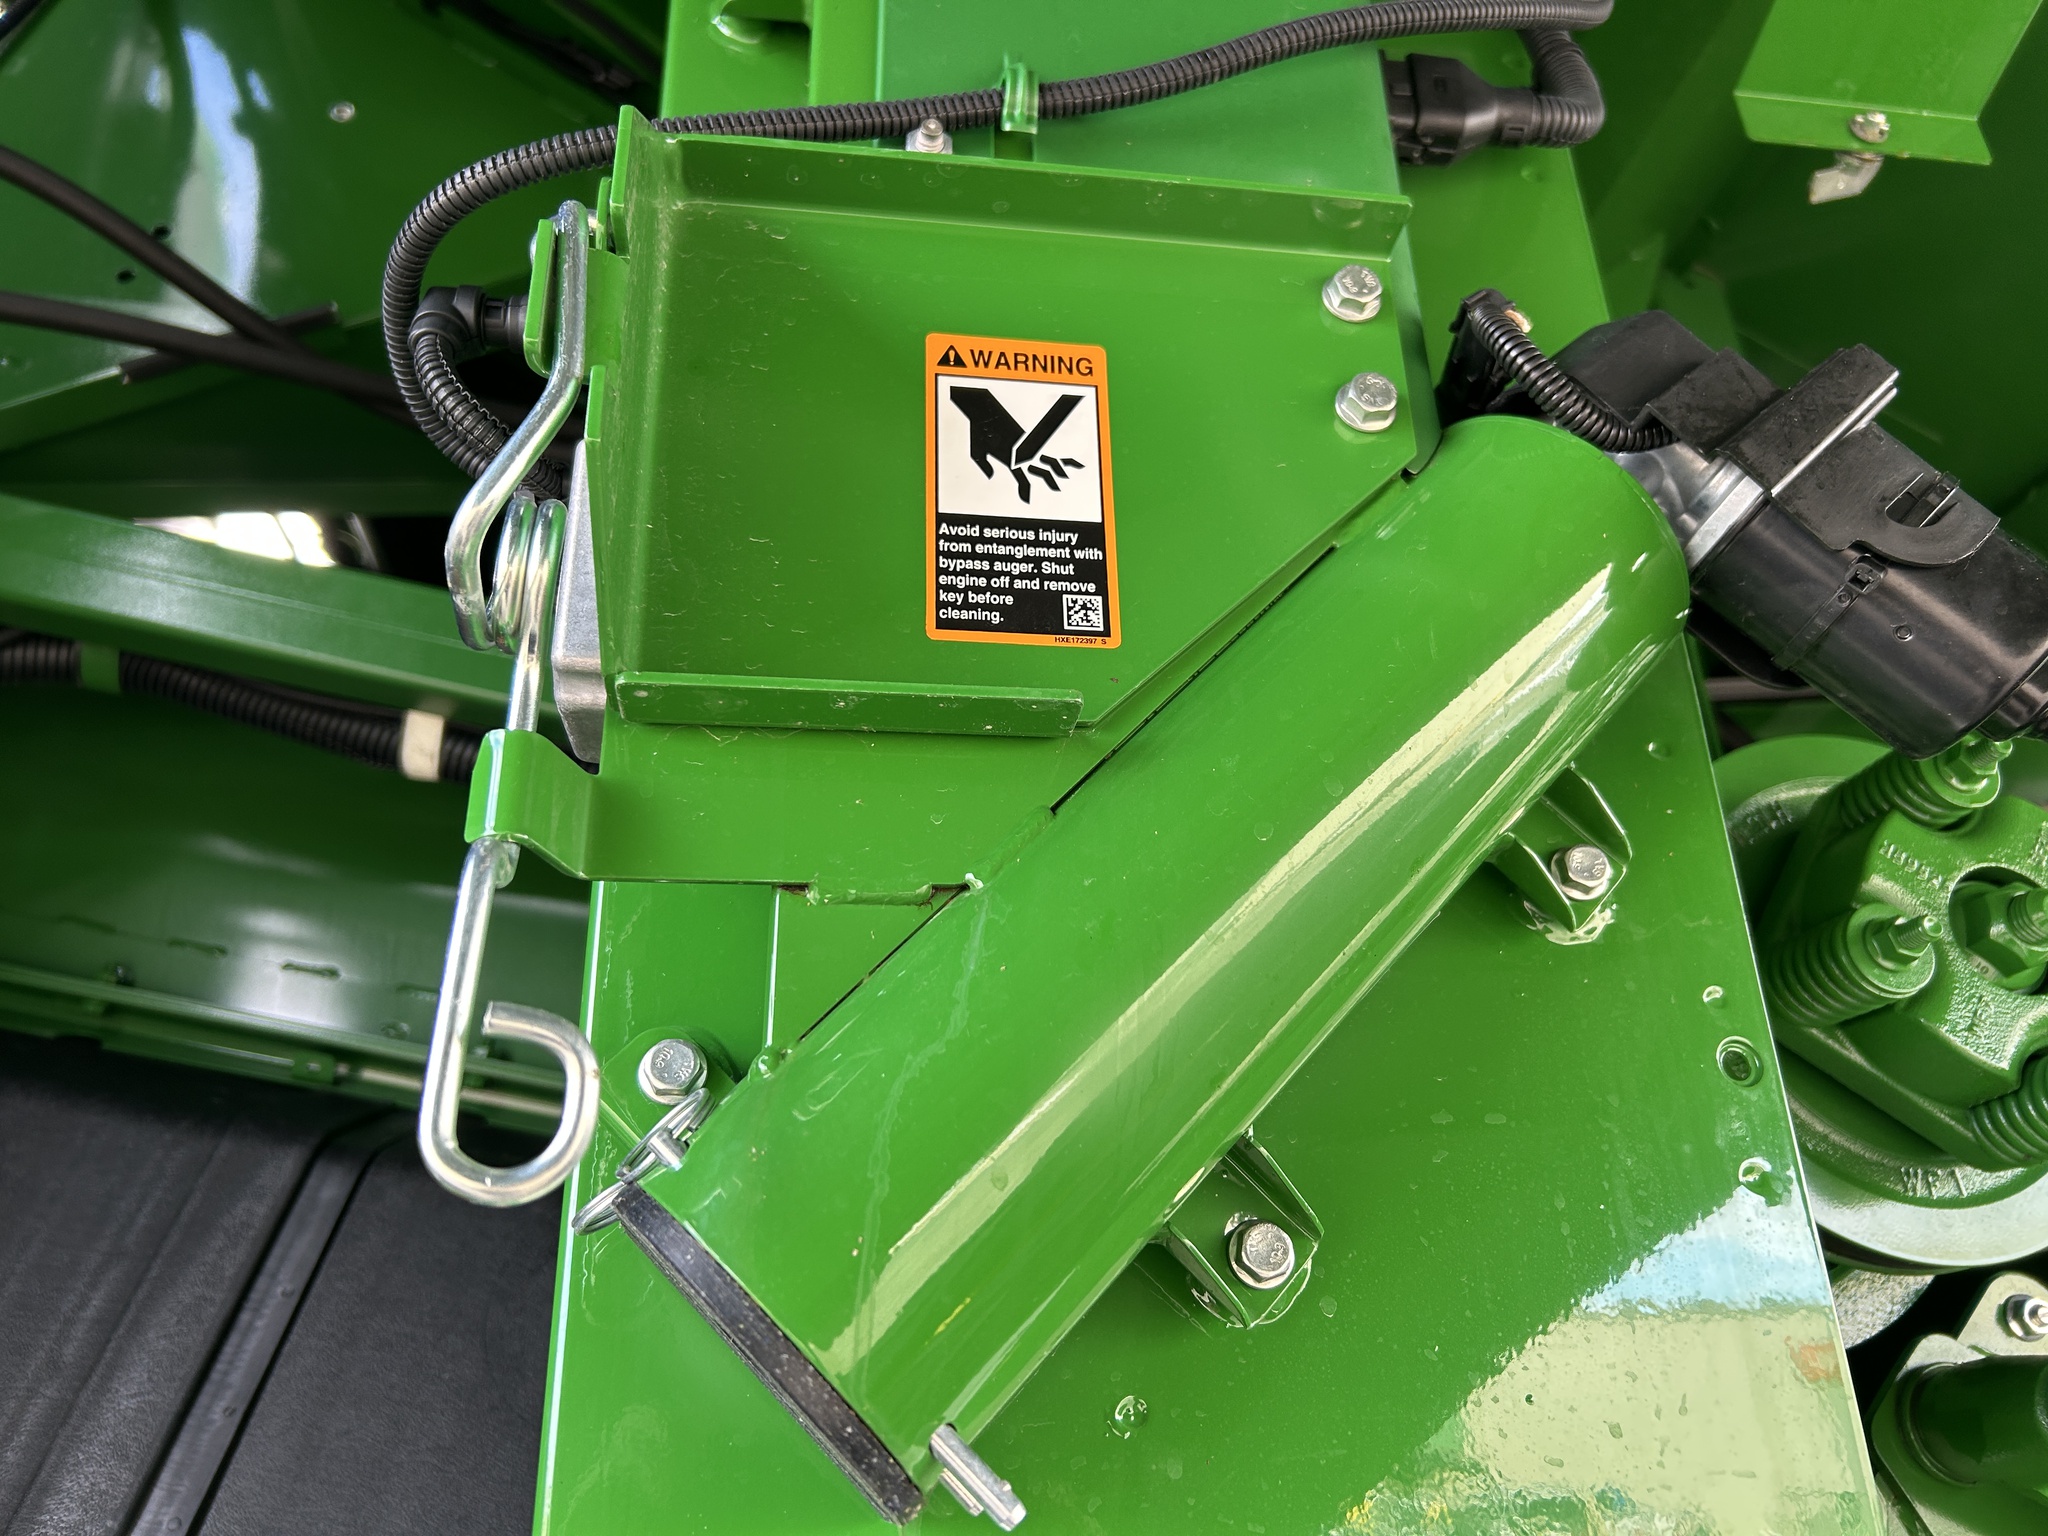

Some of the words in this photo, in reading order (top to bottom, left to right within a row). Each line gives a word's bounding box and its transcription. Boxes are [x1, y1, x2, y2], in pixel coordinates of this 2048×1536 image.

[969, 349, 1093, 377] WARNING
[939, 523, 980, 537] Avoid
[983, 527, 1034, 540] serious
[1038, 529, 1079, 545] injury
[939, 540, 972, 553] from
[975, 545, 1070, 559] entanglement
[1074, 548, 1104, 561] with
[939, 556, 990, 571] bypass
[993, 561, 1038, 575] auger.
[1041, 562, 1075, 575] Shut
[939, 574, 988, 589] engine
[990, 577, 1010, 589] off
[1013, 579, 1040, 591] and
[1043, 582, 1097, 593] remove
[939, 590, 965, 606] key
[968, 592, 1014, 606] before
[939, 607, 1005, 624] cleaning.
[1054, 636, 1097, 645] HXE172397
